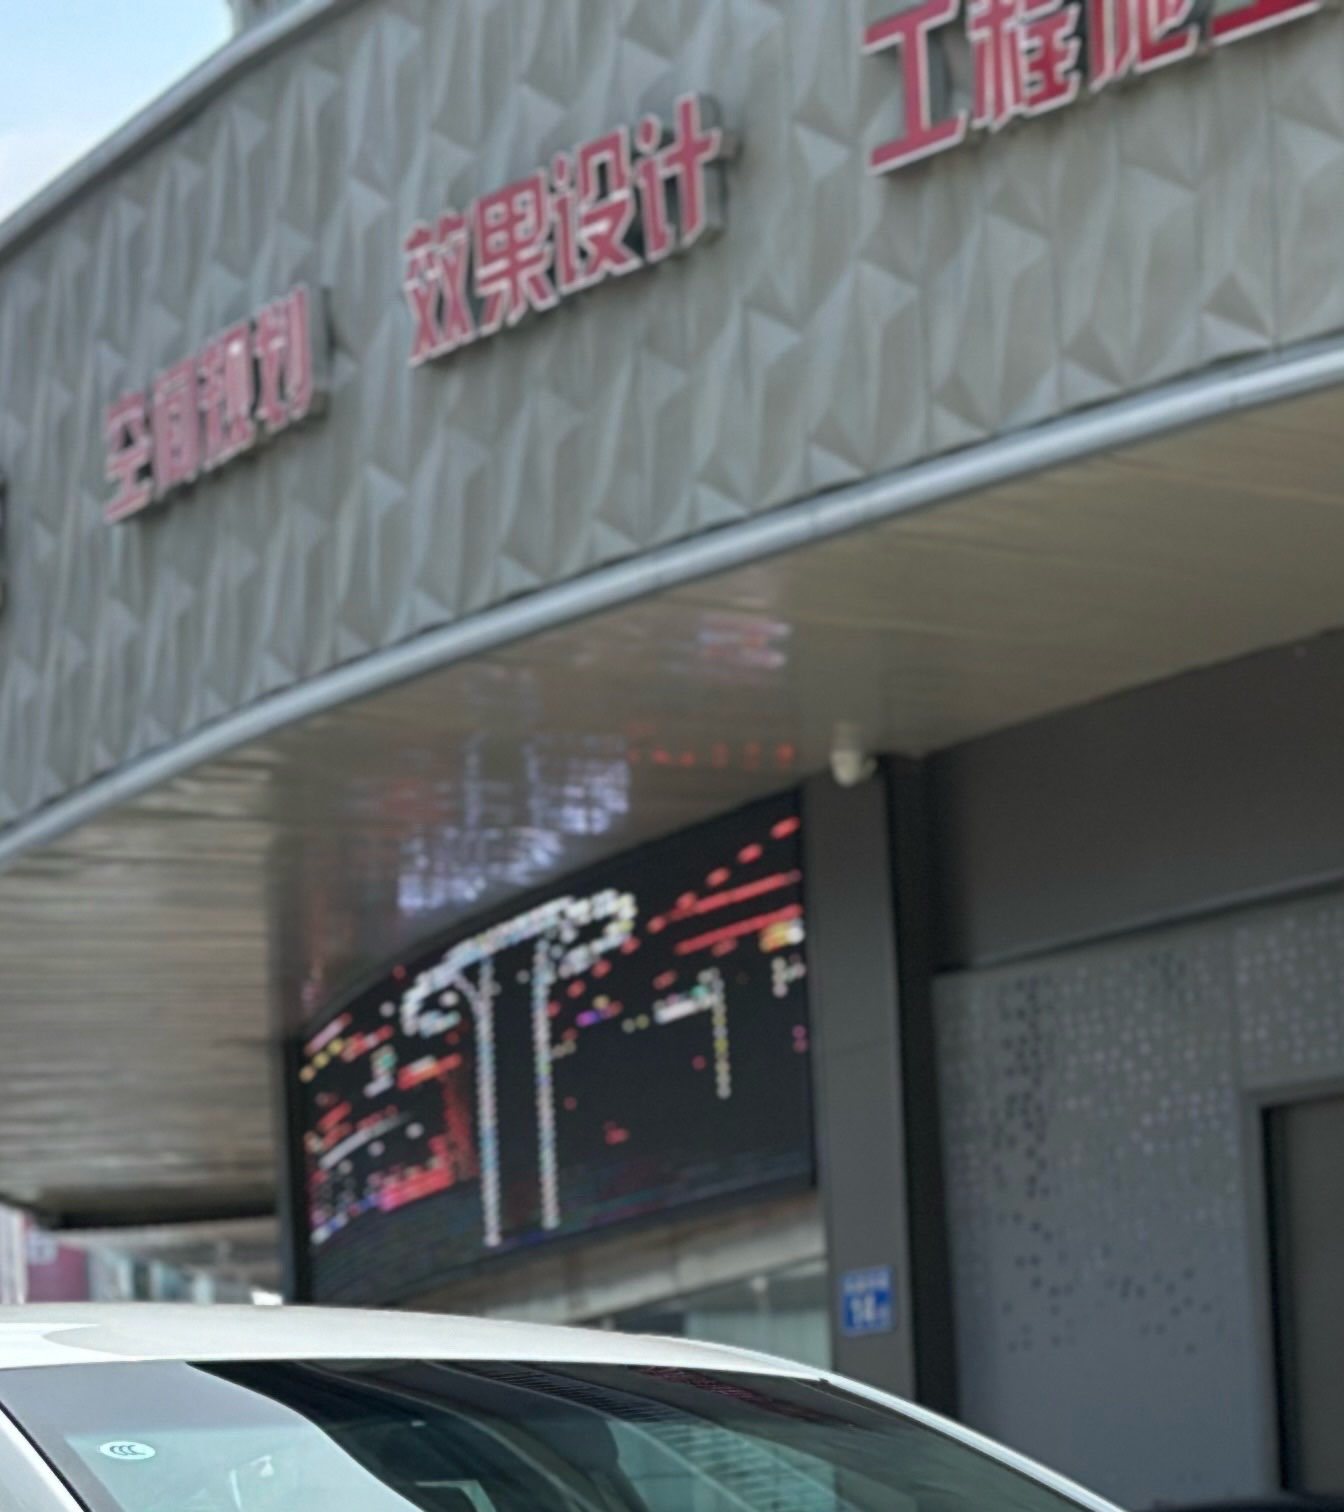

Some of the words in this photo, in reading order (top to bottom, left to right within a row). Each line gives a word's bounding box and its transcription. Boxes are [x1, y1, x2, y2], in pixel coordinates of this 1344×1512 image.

[863, 0, 1323, 177] 工程施
[404, 93, 722, 368] 效果设计
